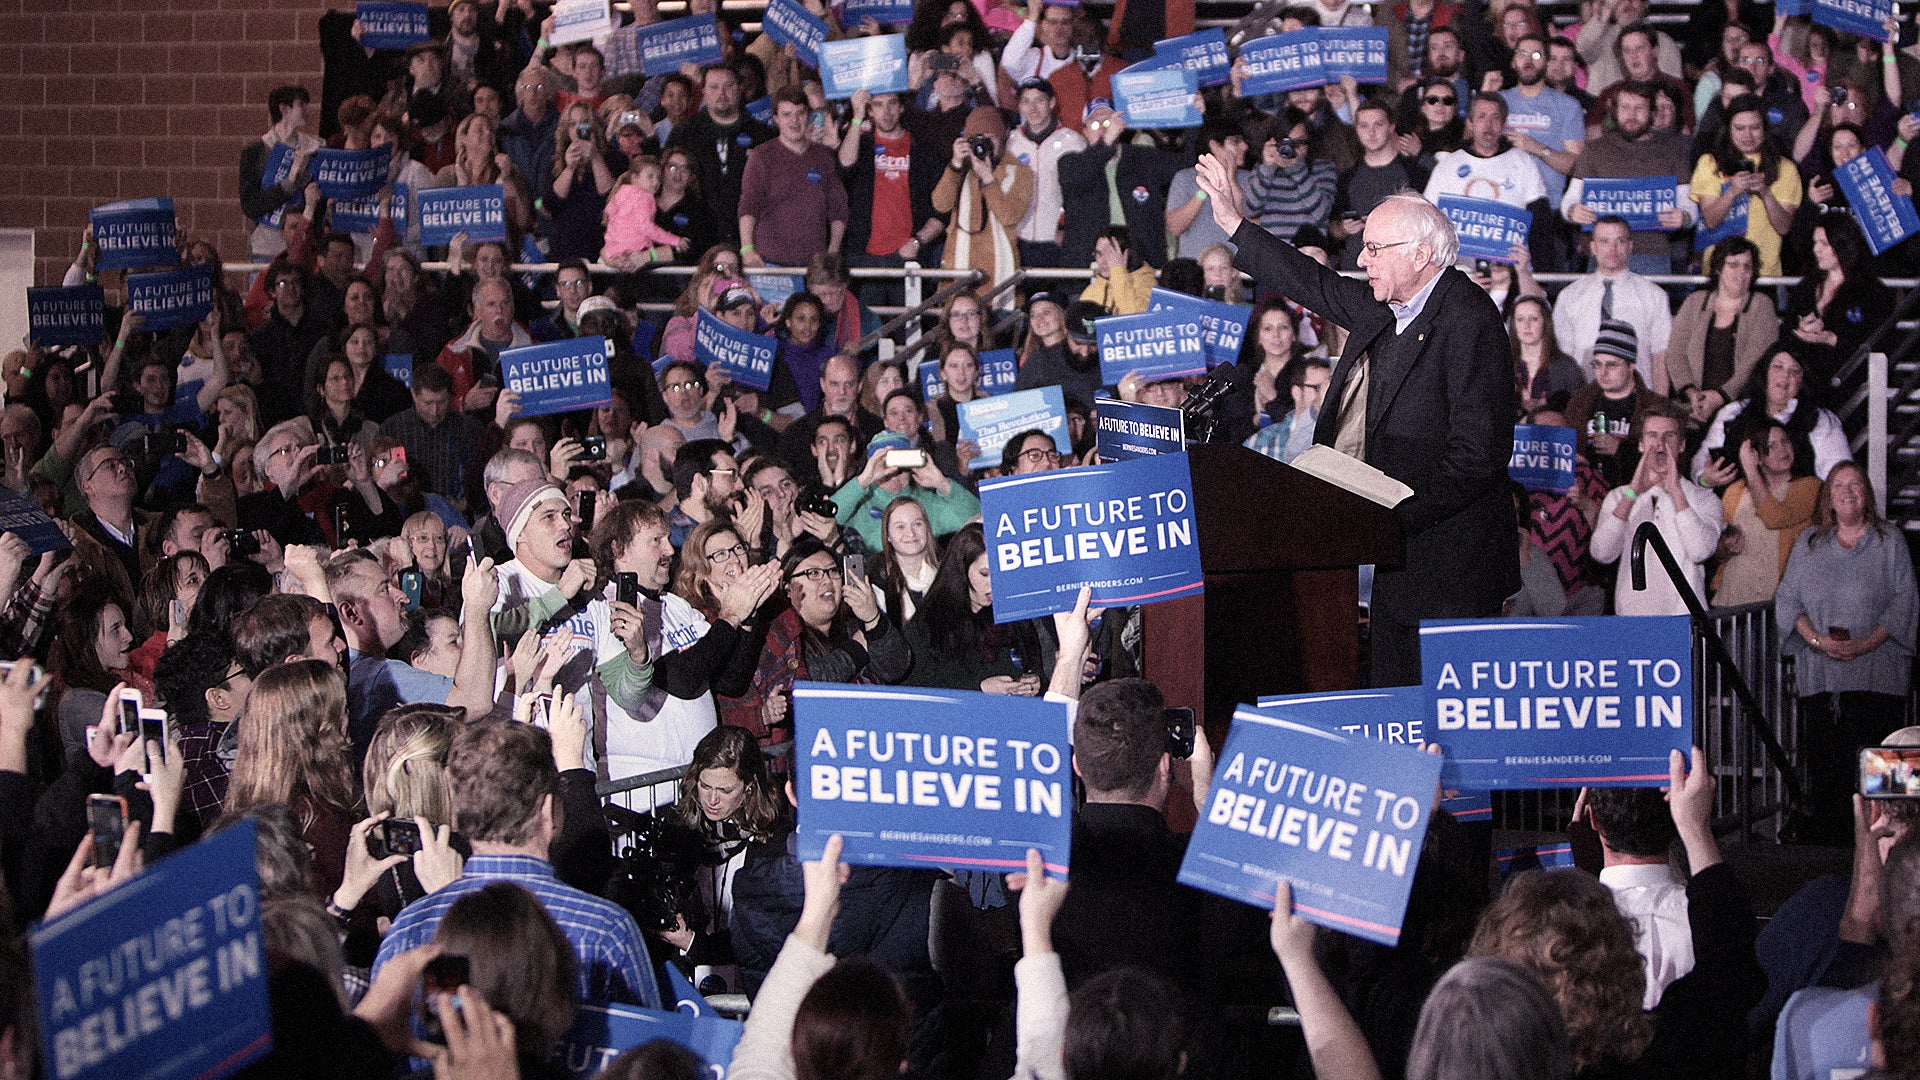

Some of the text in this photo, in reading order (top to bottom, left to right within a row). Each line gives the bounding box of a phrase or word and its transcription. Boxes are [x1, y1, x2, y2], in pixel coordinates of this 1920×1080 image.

[414, 24, 428, 34] IN
[652, 28, 697, 46] FUTURE
[700, 24, 714, 35] TO
[767, 7, 808, 43] BELIEVE
[644, 35, 718, 59] BELIEVE IN
[1208, 41, 1224, 52] TO
[1252, 44, 1298, 61] FUTURE
[1300, 42, 1320, 52] TO
[1368, 40, 1386, 50] TO
[1212, 53, 1228, 66] IN
[1304, 54, 1322, 66] IN
[1324, 52, 1386, 64] LIEVE IN
[1506, 112, 1551, 125] ernie
[320, 160, 329, 168] A
[332, 159, 376, 170] FUTURE
[1848, 164, 1862, 184] TO
[318, 169, 374, 183] BELIEVE
[422, 198, 501, 212] A FUTURE TO
[1586, 188, 1674, 200] A FUTURE TO
[1856, 156, 1904, 239] BELIEVE IN
[335, 201, 380, 217] BELIEV
[423, 210, 502, 226] BELIEVE IN
[1859, 182, 1888, 233] FUTURE
[98, 222, 175, 236] A FUTURE TO
[1452, 208, 1506, 229] FUTURE
[1509, 218, 1528, 232] TO
[98, 234, 176, 249] BELIEVE IN
[1452, 221, 1524, 244] LIEVE IN
[133, 276, 210, 298] A FUTURE TO
[32, 300, 103, 312] A FUTURE TO
[133, 289, 212, 311] BELIEVE IN
[33, 312, 104, 326] BELIEVE IN
[1224, 320, 1243, 334] TO
[706, 324, 750, 352] FUTURE
[752, 346, 772, 360] TO
[1103, 333, 1114, 345] A
[1115, 326, 1173, 344] FUTURE
[1176, 322, 1198, 336] TO
[1218, 334, 1240, 350] IN
[698, 330, 770, 374] BELIEVE IN
[1104, 337, 1200, 362] BELIEVE IN
[509, 352, 604, 378] A FUTURE TO
[926, 374, 936, 382] A
[994, 360, 1014, 371] TO
[510, 368, 606, 394] BELIEVE IN
[996, 372, 1016, 384] IN
[1099, 416, 1180, 442] A FUTURE TO BELIEVE IN
[1553, 442, 1572, 456] TO
[1554, 458, 1572, 473] IN
[996, 488, 1187, 538] A FUTURE TO
[997, 518, 1192, 572] BELIEVE IN
[1056, 576, 1144, 593] BERNIESANDERS.COM
[1436, 658, 1682, 691] A FUTURE TO
[1436, 695, 1682, 730] BELIEVE IN
[810, 728, 1061, 775] A FUTURE TO
[1504, 754, 1612, 766] BERNIESANDERS.COM
[810, 764, 1063, 818] BELIEVE IN
[1223, 752, 1420, 830] A FUTURE TO
[1208, 788, 1412, 877] BELIEVE IN
[52, 883, 255, 1021] A FUTURE TO
[54, 932, 260, 1079] BELIEVE IN
